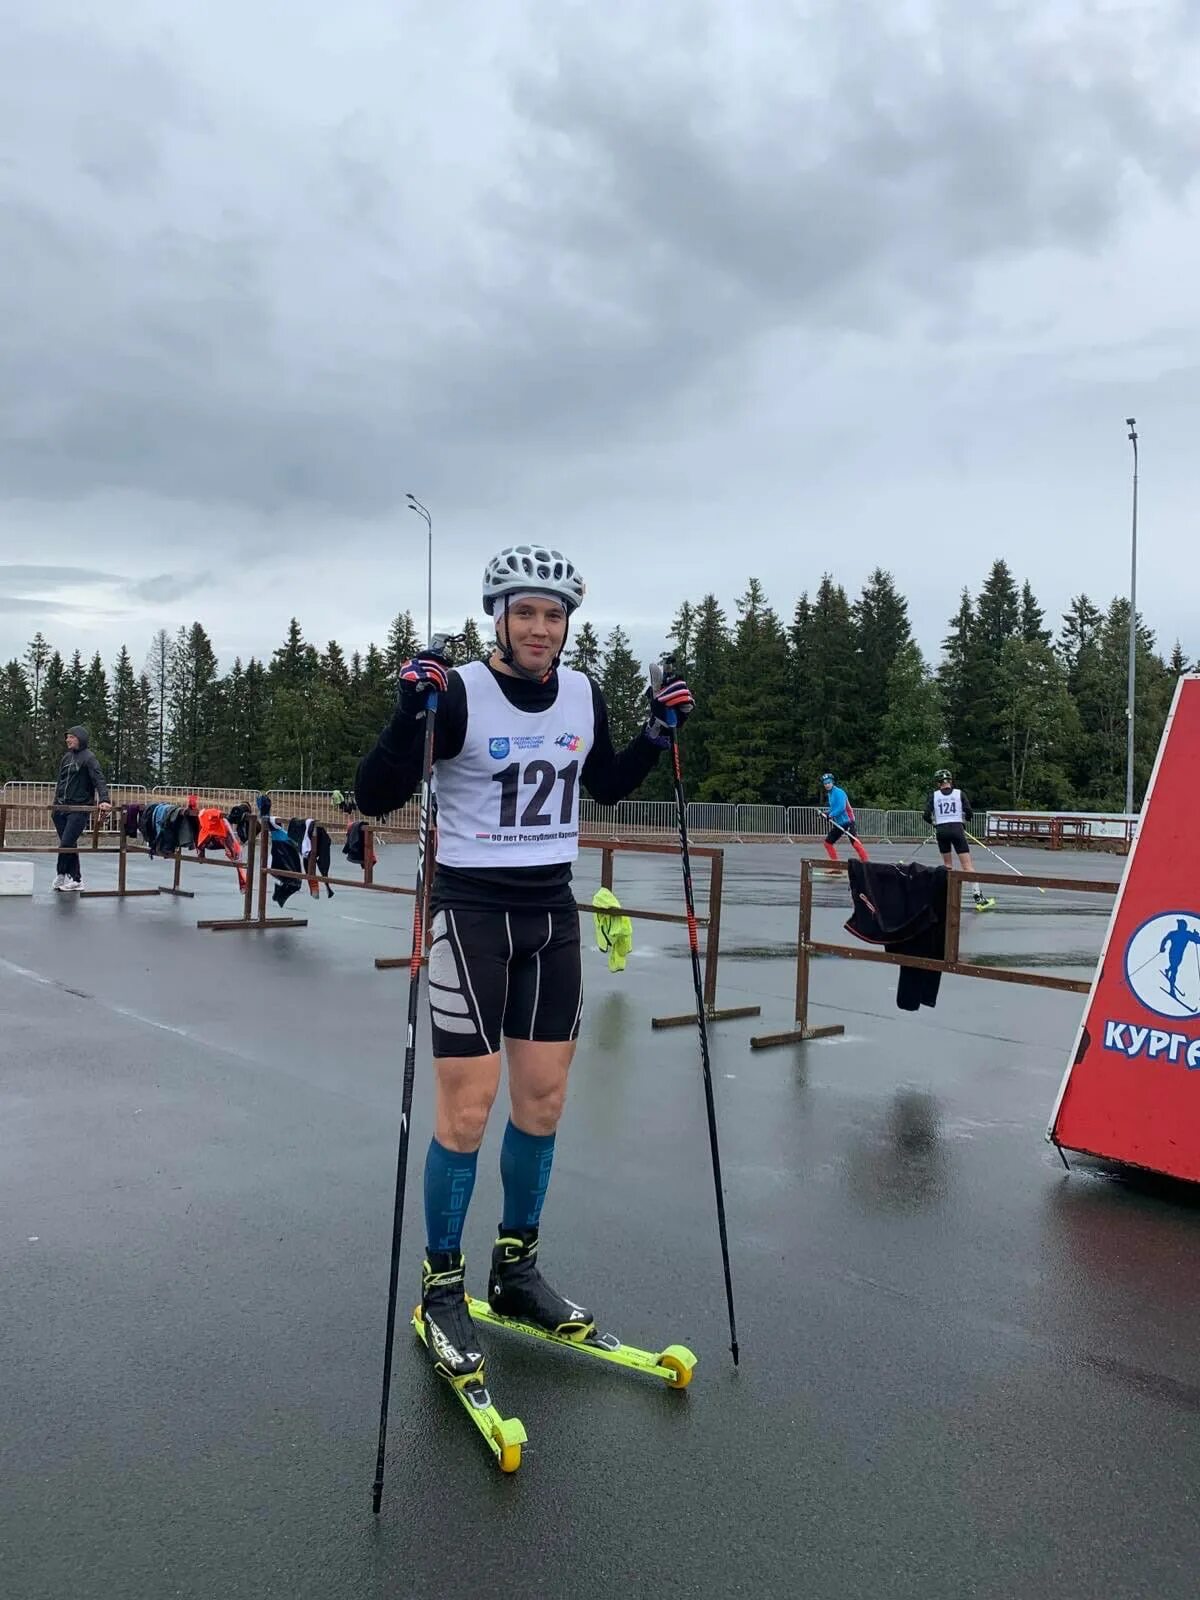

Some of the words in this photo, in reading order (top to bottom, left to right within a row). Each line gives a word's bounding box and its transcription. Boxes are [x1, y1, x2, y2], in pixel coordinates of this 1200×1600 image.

[492, 759, 579, 827] 121
[937, 802, 957, 815] 124
[491, 834, 502, 842] 90
[503, 834, 517, 842] лет
[438, 1167, 473, 1250] kalenji
